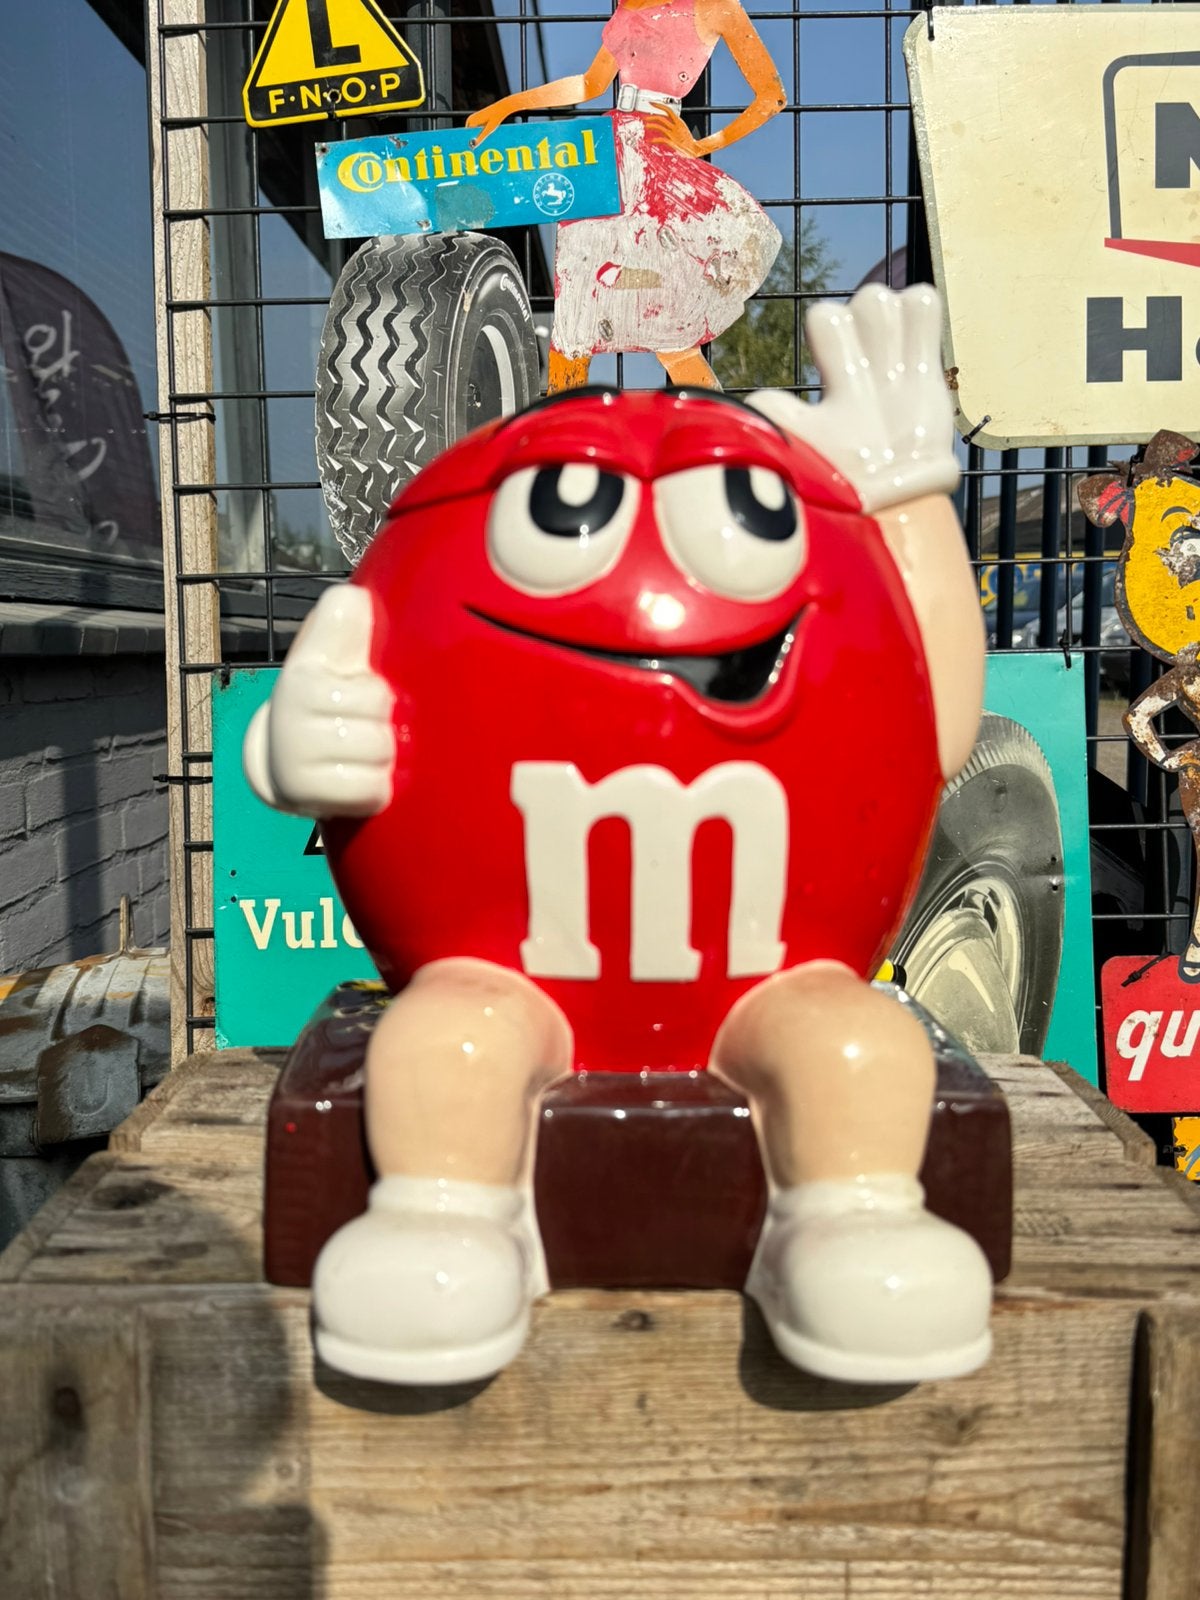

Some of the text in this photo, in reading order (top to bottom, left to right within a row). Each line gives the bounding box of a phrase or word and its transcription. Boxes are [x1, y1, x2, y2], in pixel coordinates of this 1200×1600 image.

[305, 0, 362, 68] L
[337, 129, 598, 193] Continental
[1086, 295, 1200, 383] H
[510, 759, 790, 983] m
